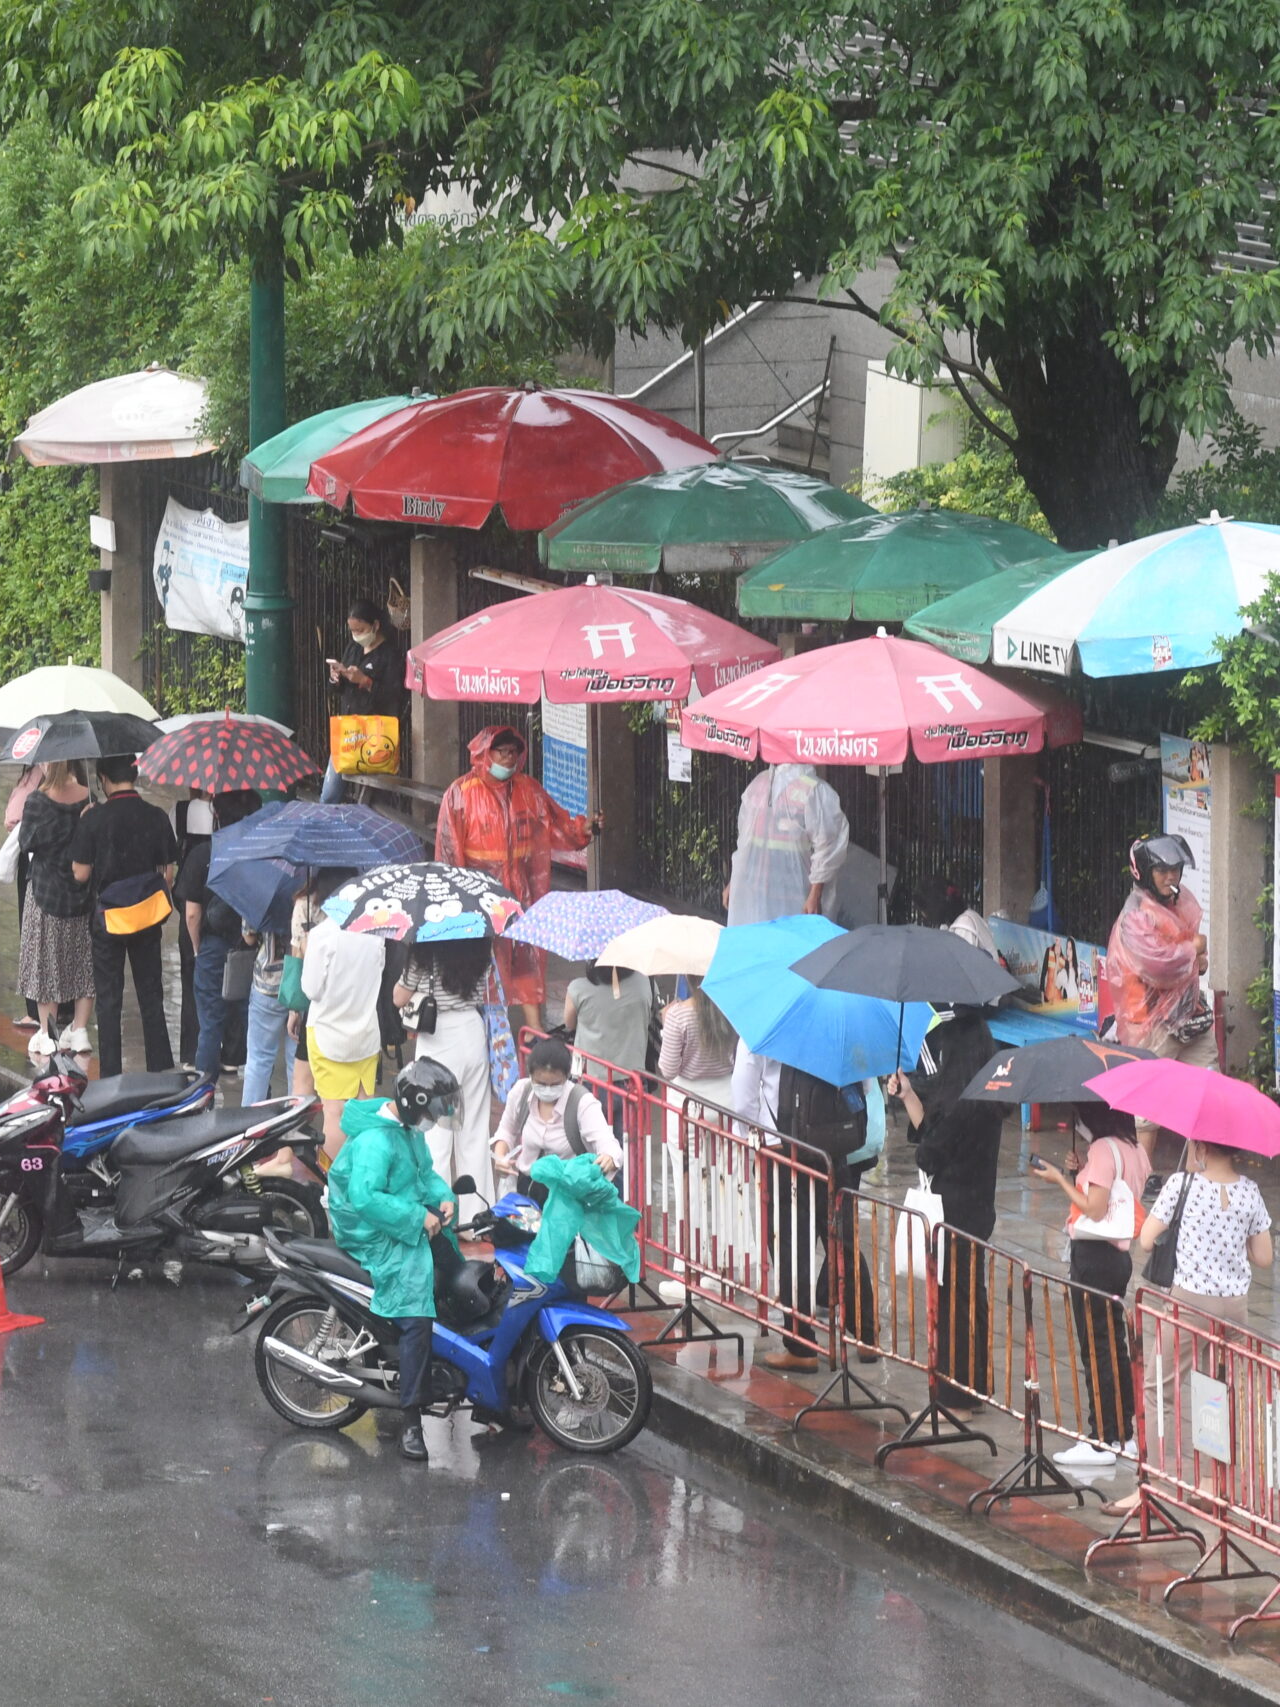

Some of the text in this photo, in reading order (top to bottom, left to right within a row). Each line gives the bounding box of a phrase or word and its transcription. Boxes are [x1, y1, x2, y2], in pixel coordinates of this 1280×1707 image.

[402, 495, 446, 521] Birdy
[1020, 640, 1069, 666] LINE TV
[20, 1157, 43, 1172] 63
